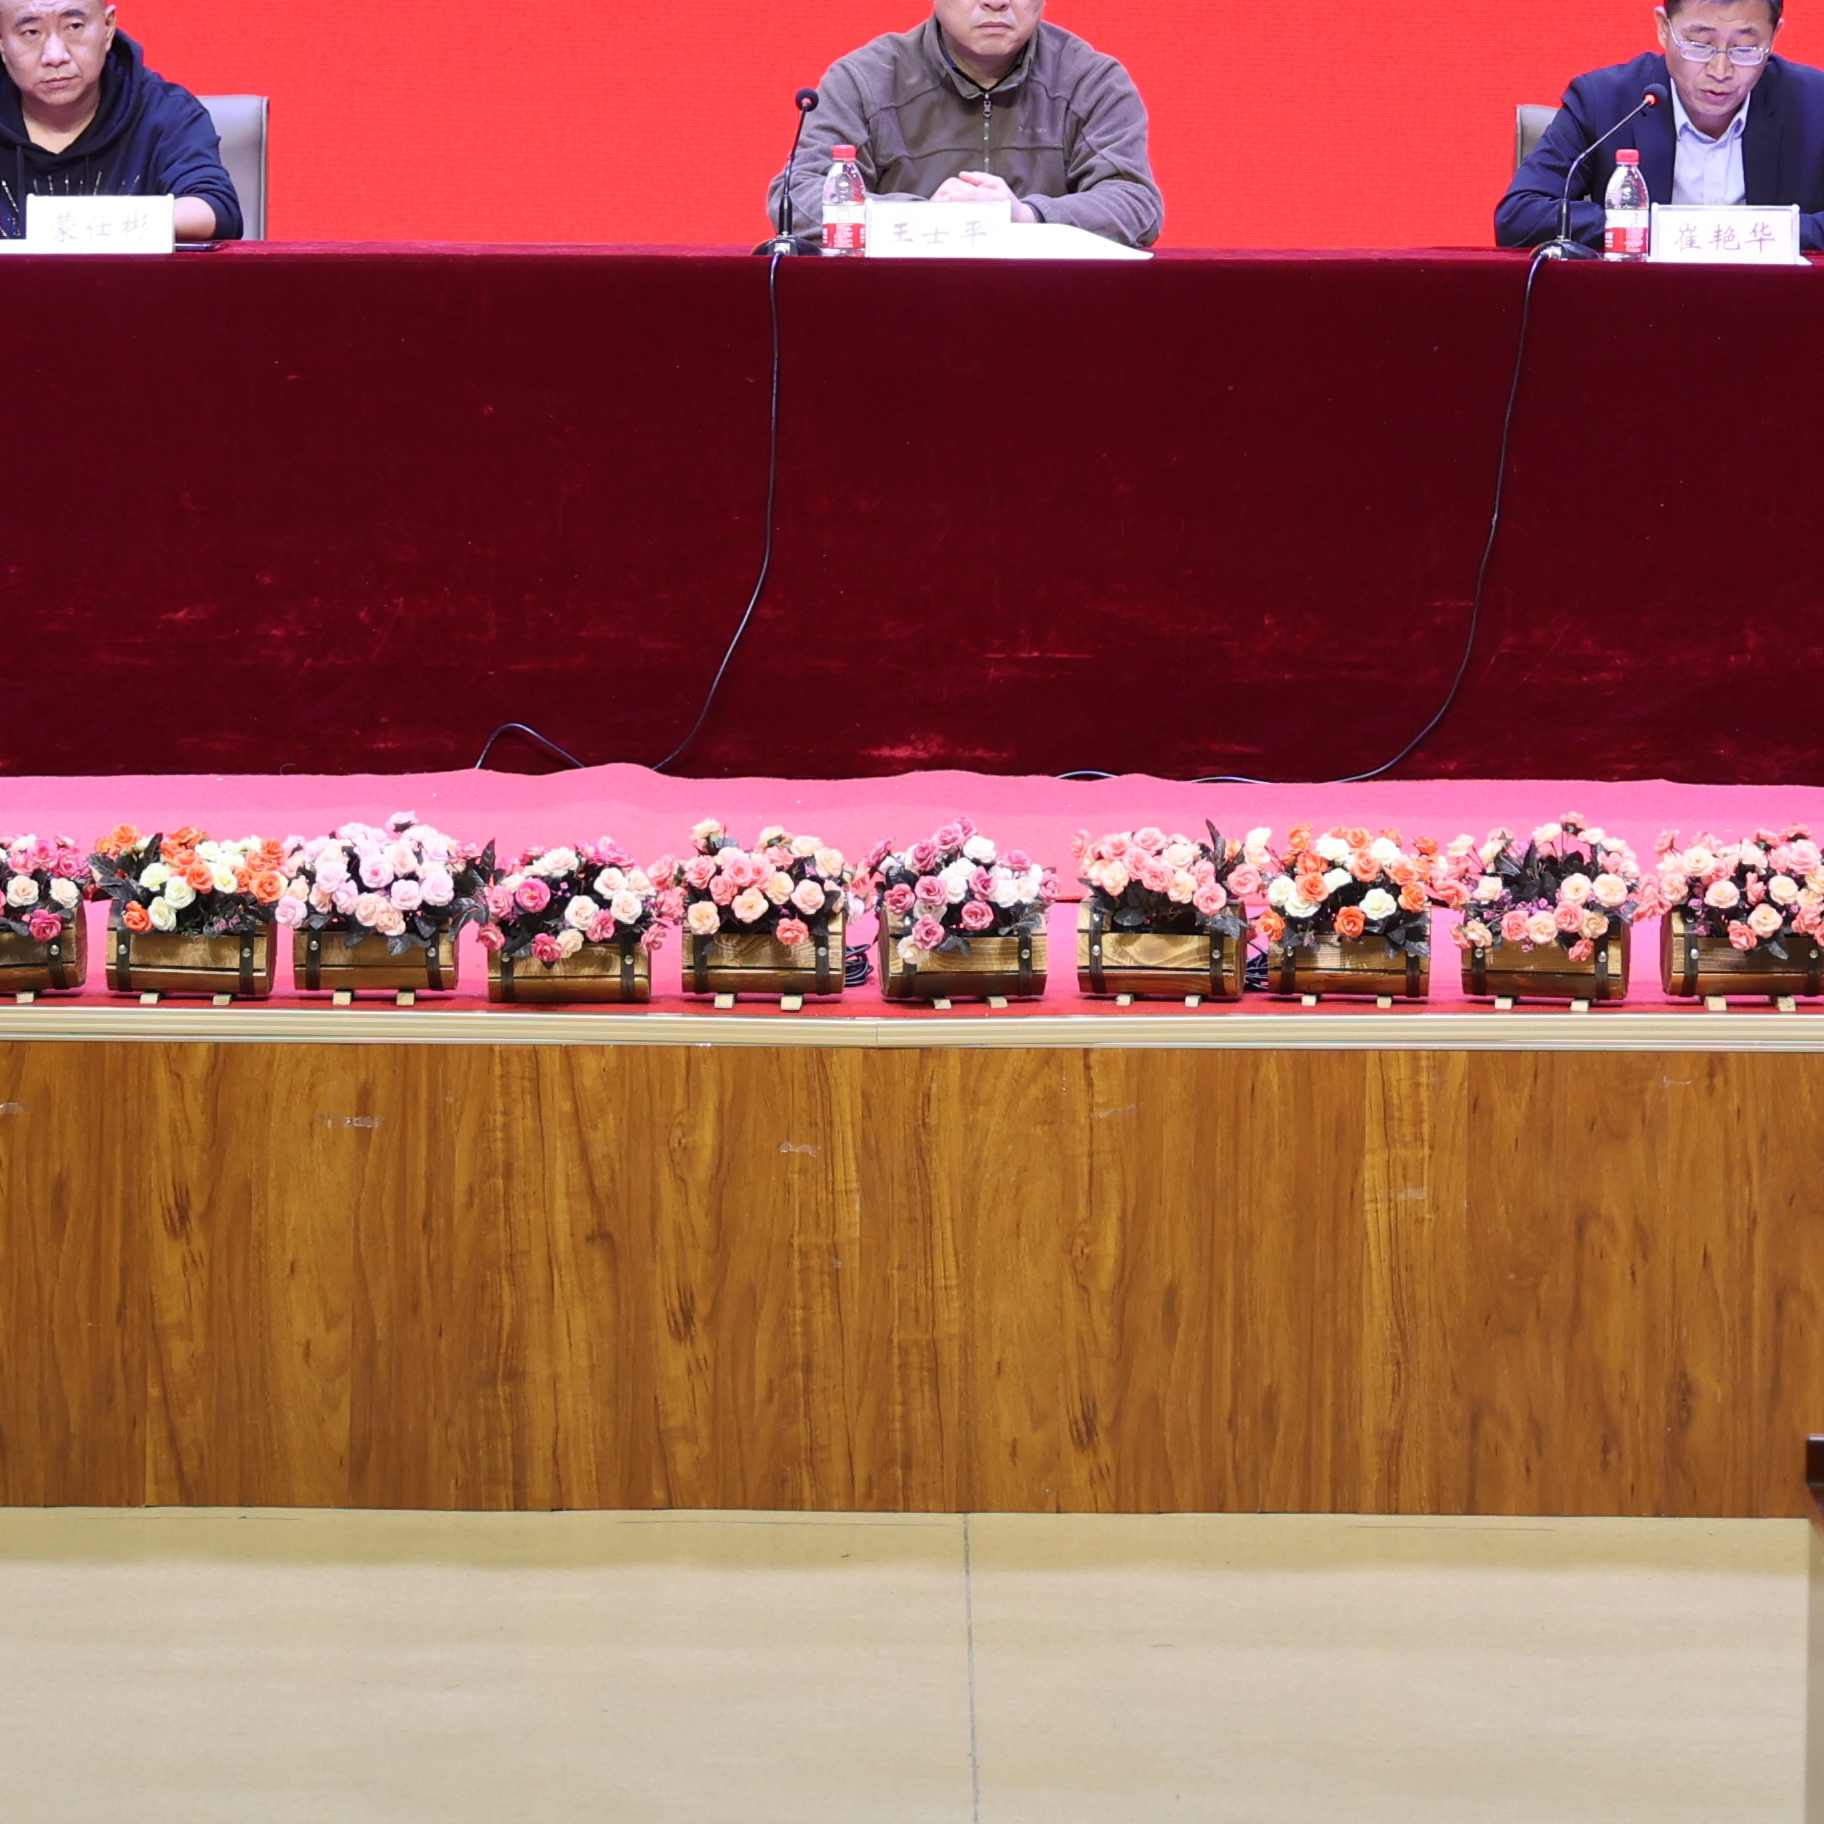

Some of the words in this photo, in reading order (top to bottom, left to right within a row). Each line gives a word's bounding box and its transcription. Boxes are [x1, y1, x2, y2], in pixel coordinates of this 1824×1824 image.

[893, 220, 988, 248] 王士平
[1674, 221, 1776, 253] 崔艳华
